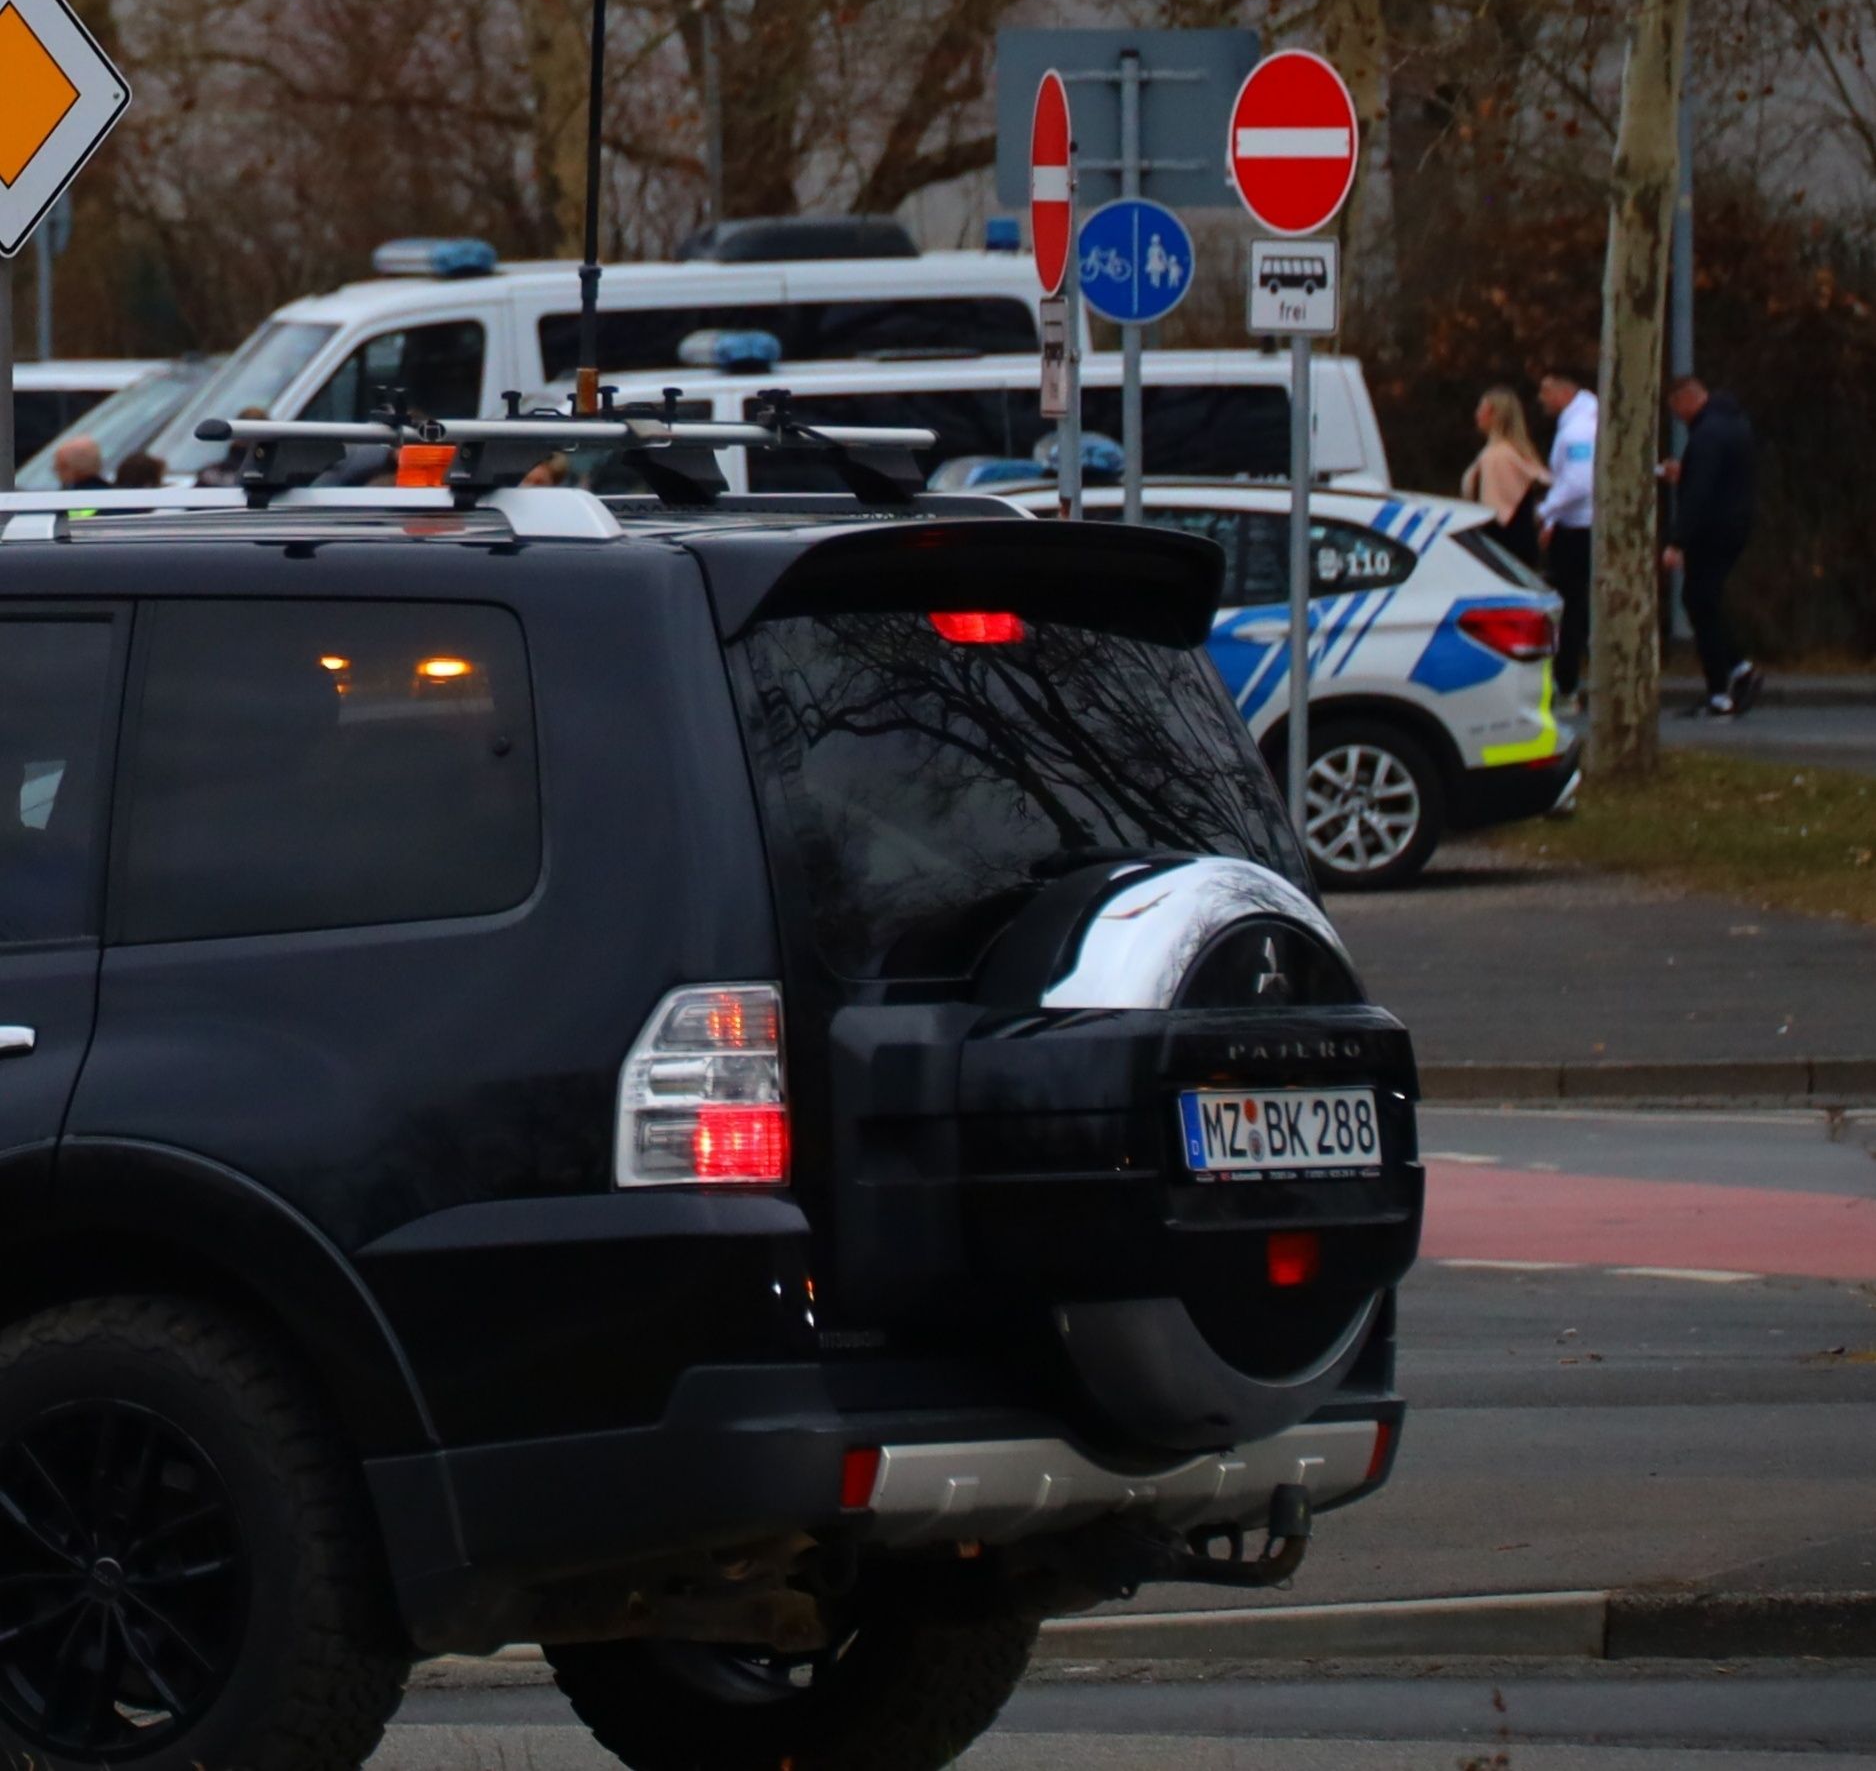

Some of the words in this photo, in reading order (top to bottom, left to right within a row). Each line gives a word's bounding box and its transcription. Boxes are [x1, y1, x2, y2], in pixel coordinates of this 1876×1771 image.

[1279, 300, 1307, 323] frei
[1346, 549, 1390, 577] 110
[1201, 1102, 1248, 1159] MZ
[1264, 1100, 1309, 1158] BK
[1312, 1099, 1376, 1156] 288
